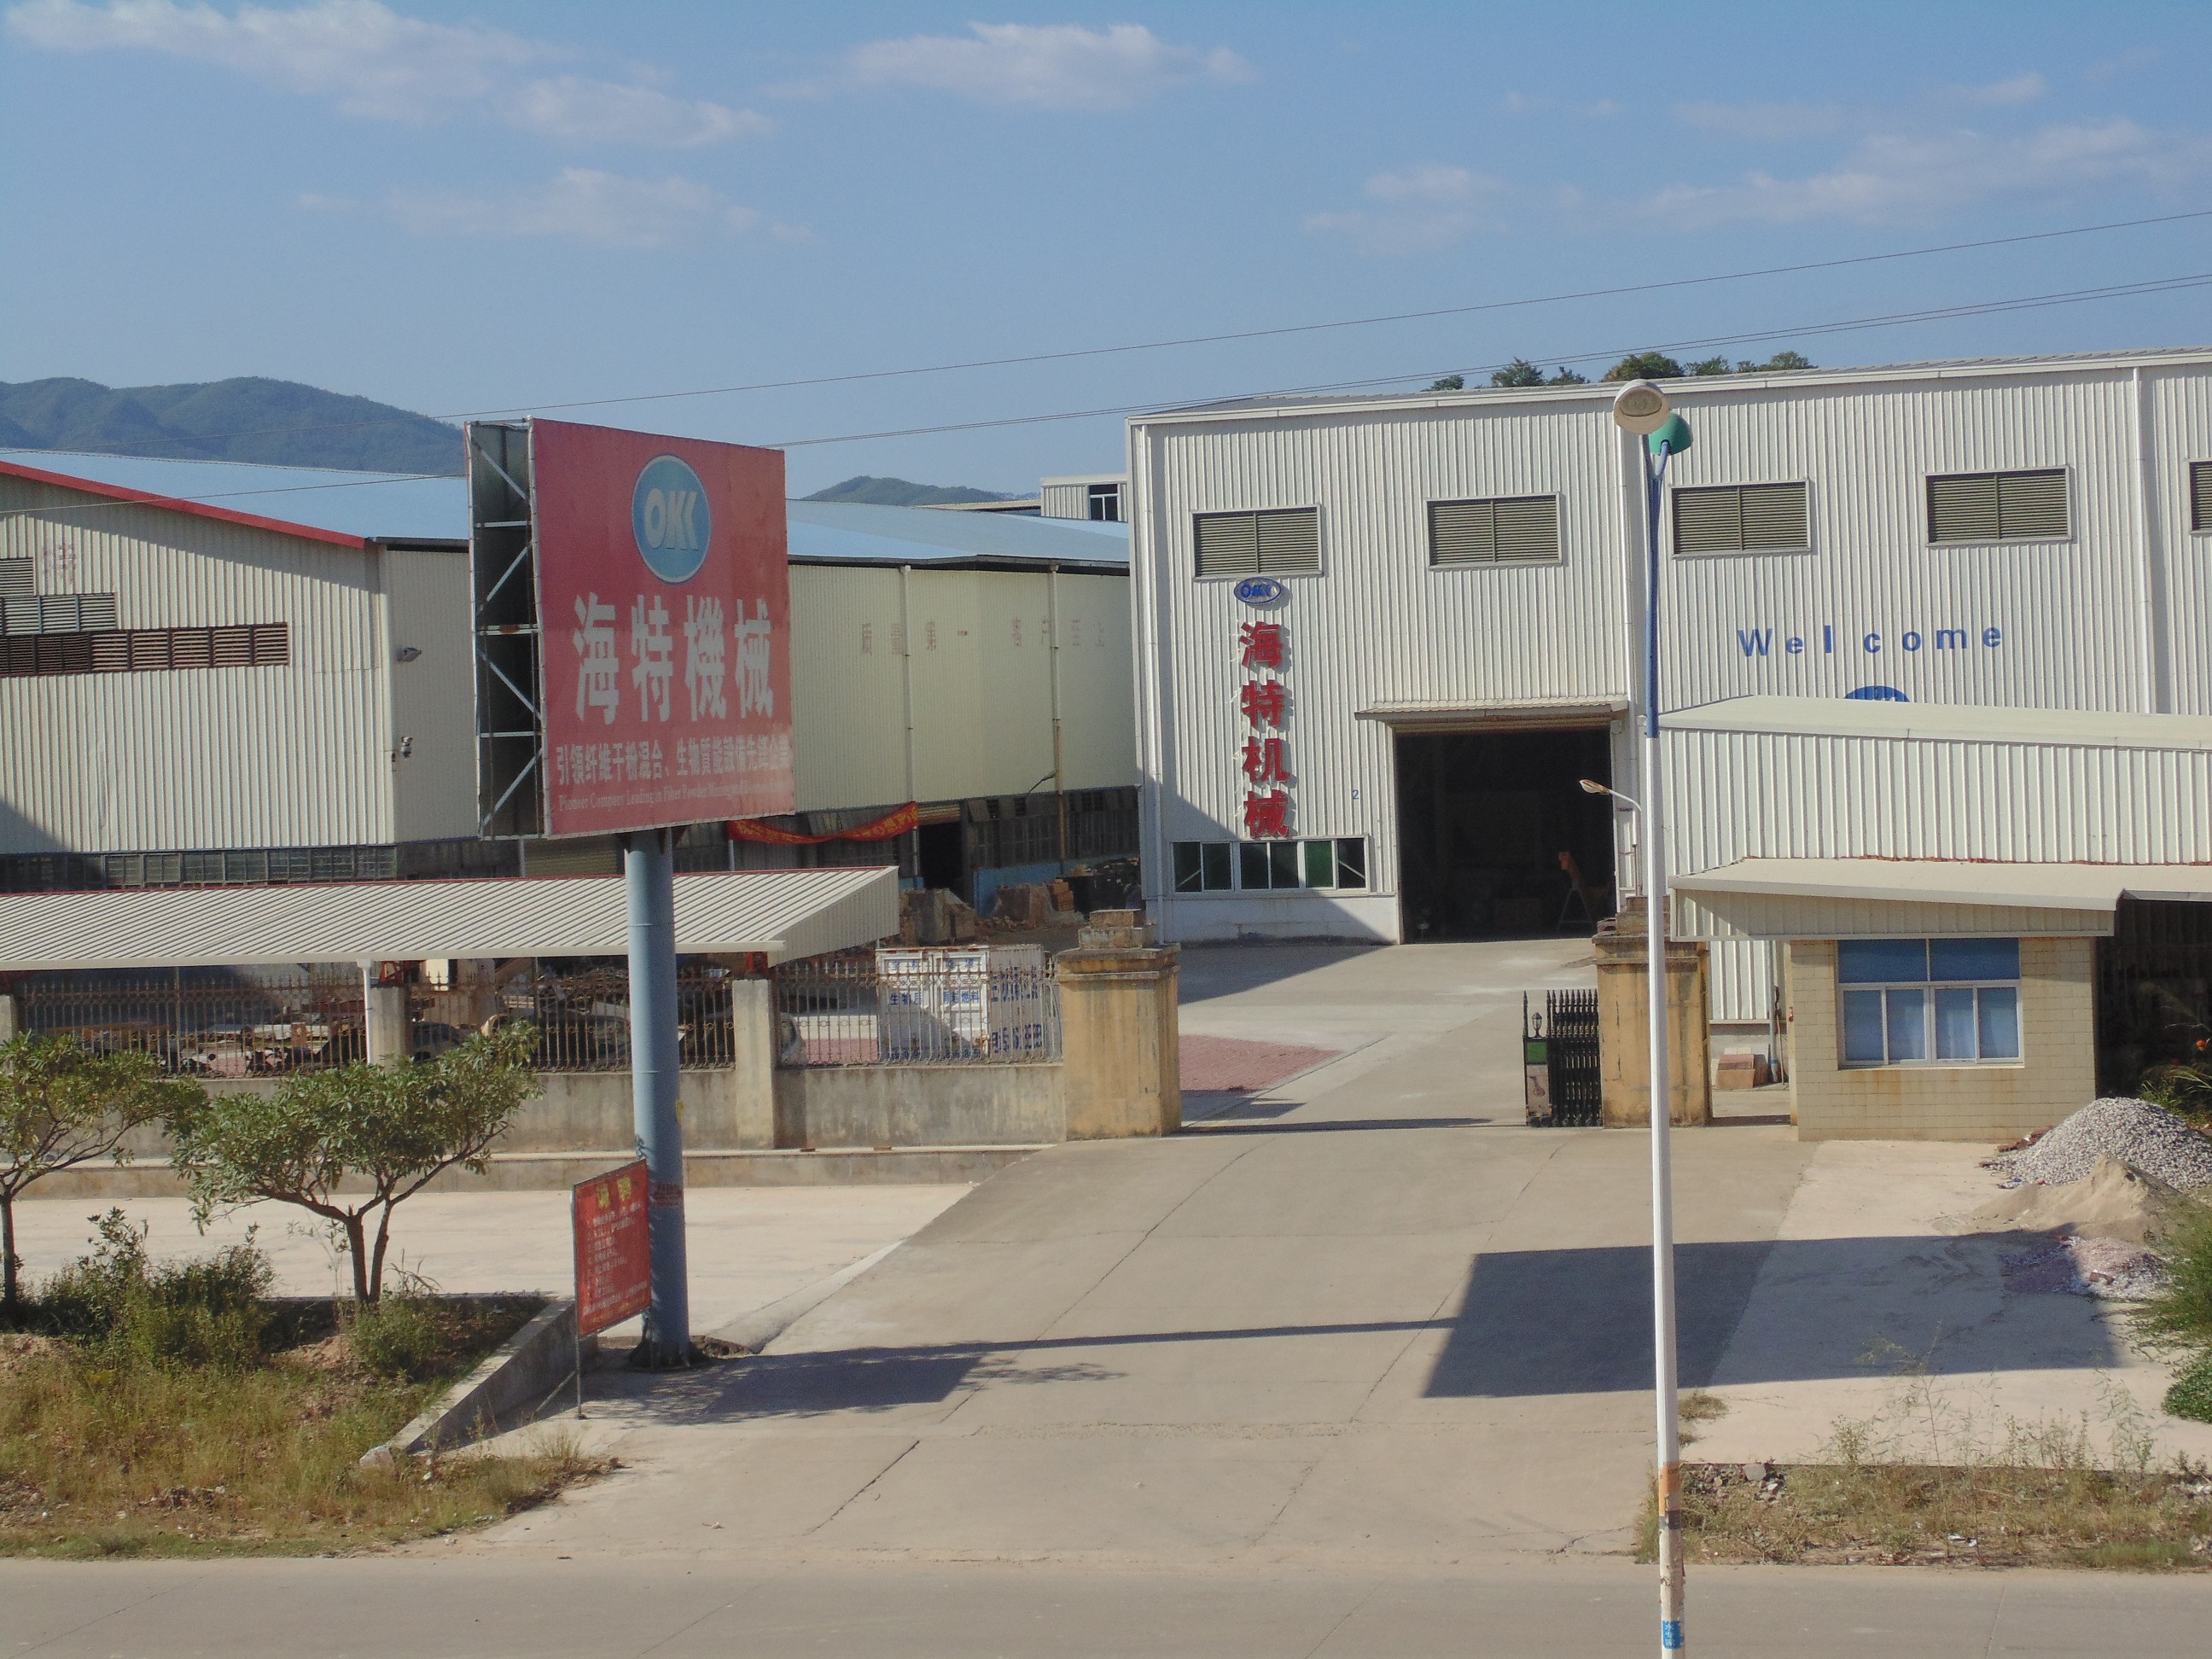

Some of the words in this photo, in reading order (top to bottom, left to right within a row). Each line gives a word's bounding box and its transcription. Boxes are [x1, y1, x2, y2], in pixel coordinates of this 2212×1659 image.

[573, 592, 773, 725] 海特機械
[1738, 626, 2001, 656] Welcome
[1239, 621, 1289, 838] 海特机械
[1352, 789, 1359, 800] 2
